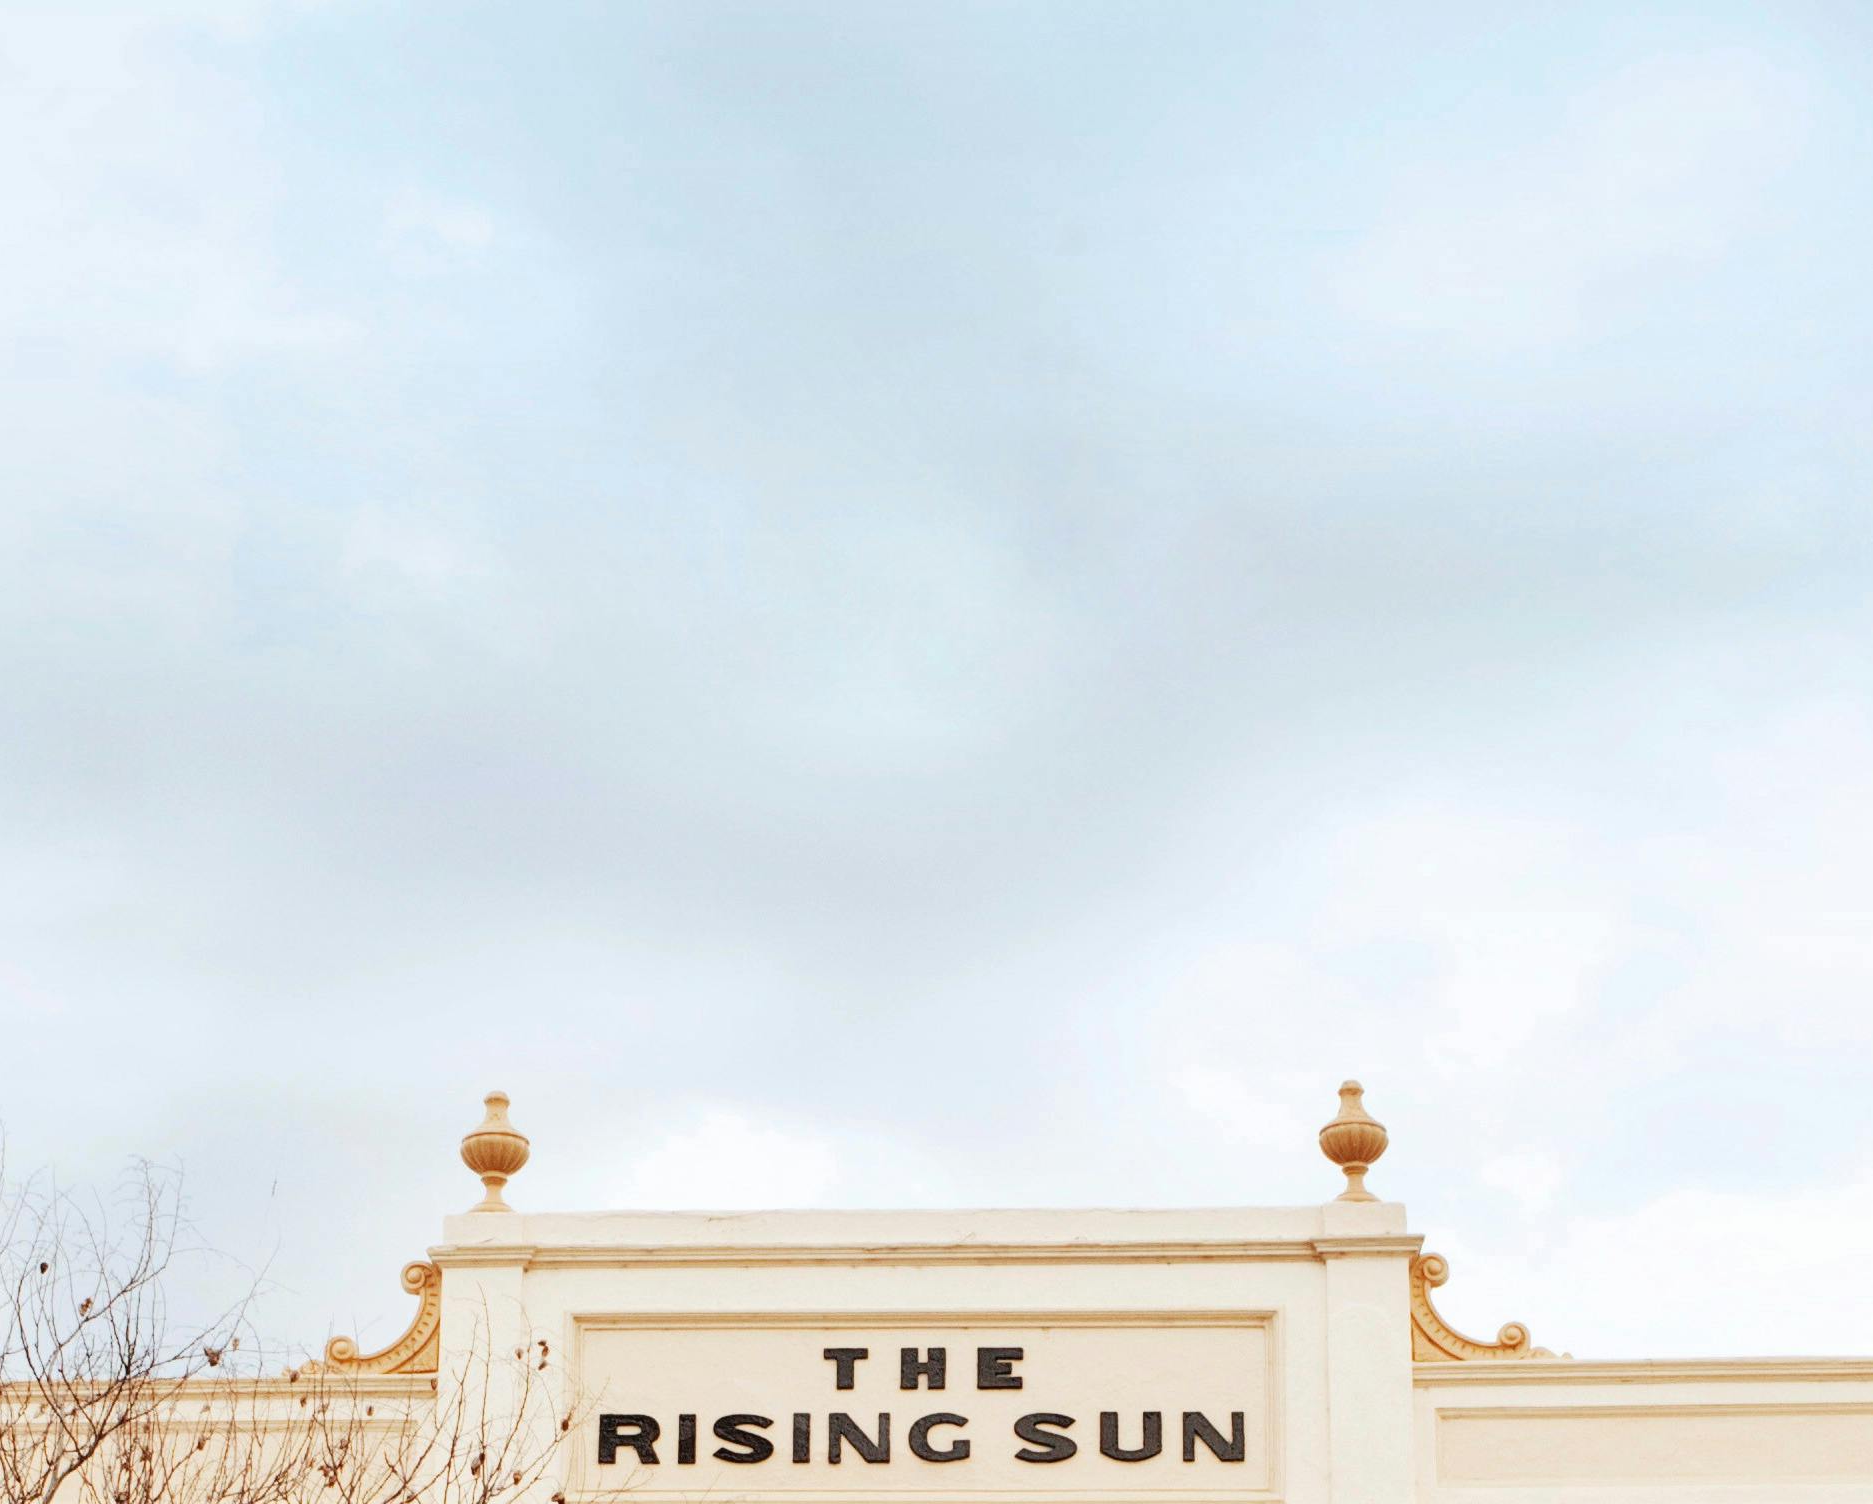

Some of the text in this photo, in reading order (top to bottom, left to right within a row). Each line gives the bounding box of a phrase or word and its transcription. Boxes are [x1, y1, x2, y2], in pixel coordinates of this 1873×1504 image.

[823, 1347, 1024, 1390] THE
[598, 1412, 1246, 1464] RISING SUN
